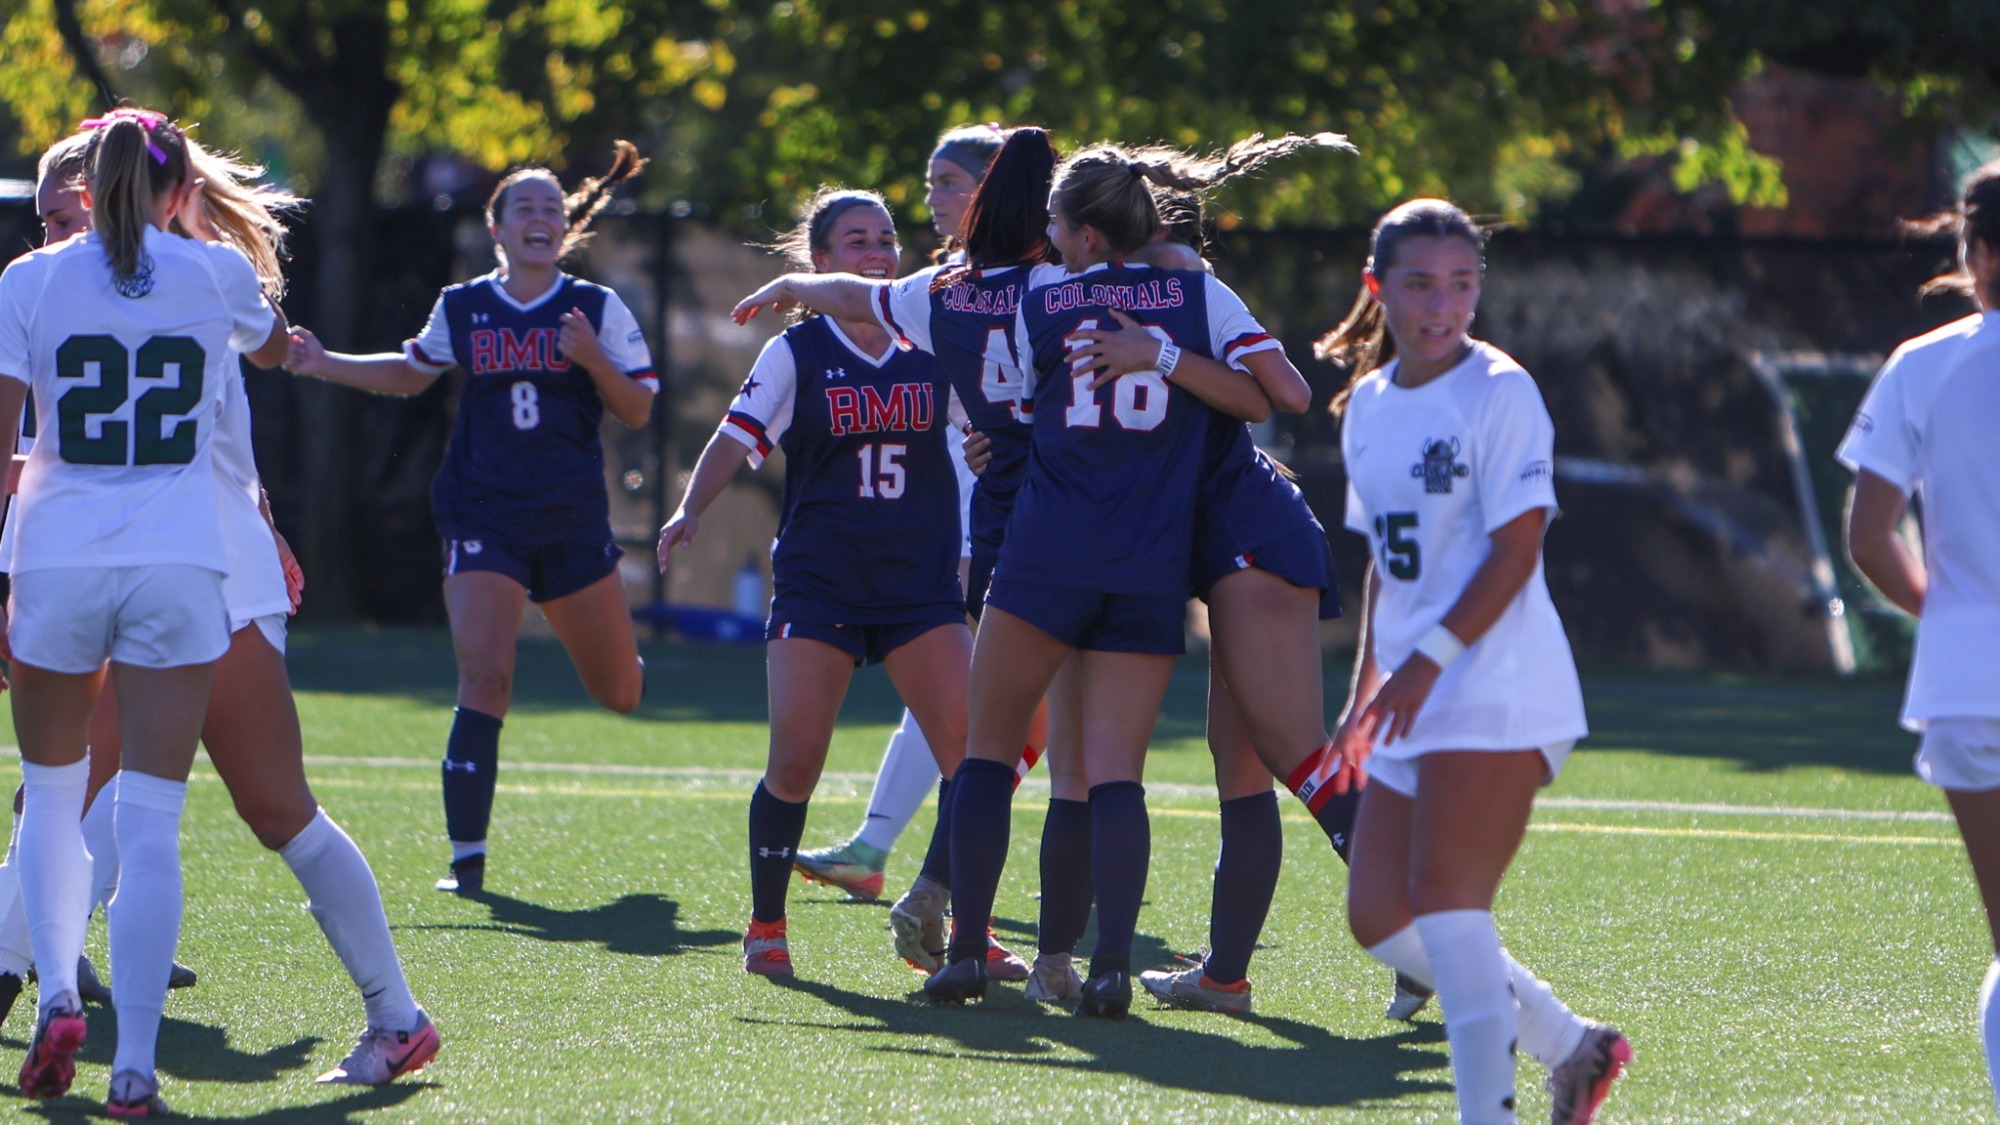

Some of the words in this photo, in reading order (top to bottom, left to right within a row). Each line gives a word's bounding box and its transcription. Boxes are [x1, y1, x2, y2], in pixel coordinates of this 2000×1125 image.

[1045, 277, 1184, 315] COLONIALS
[471, 327, 572, 374] RMU
[980, 325, 1023, 420] 4
[56, 333, 206, 466] 22
[511, 380, 540, 430] 8
[825, 382, 933, 436] RMU
[857, 442, 907, 499] 15
